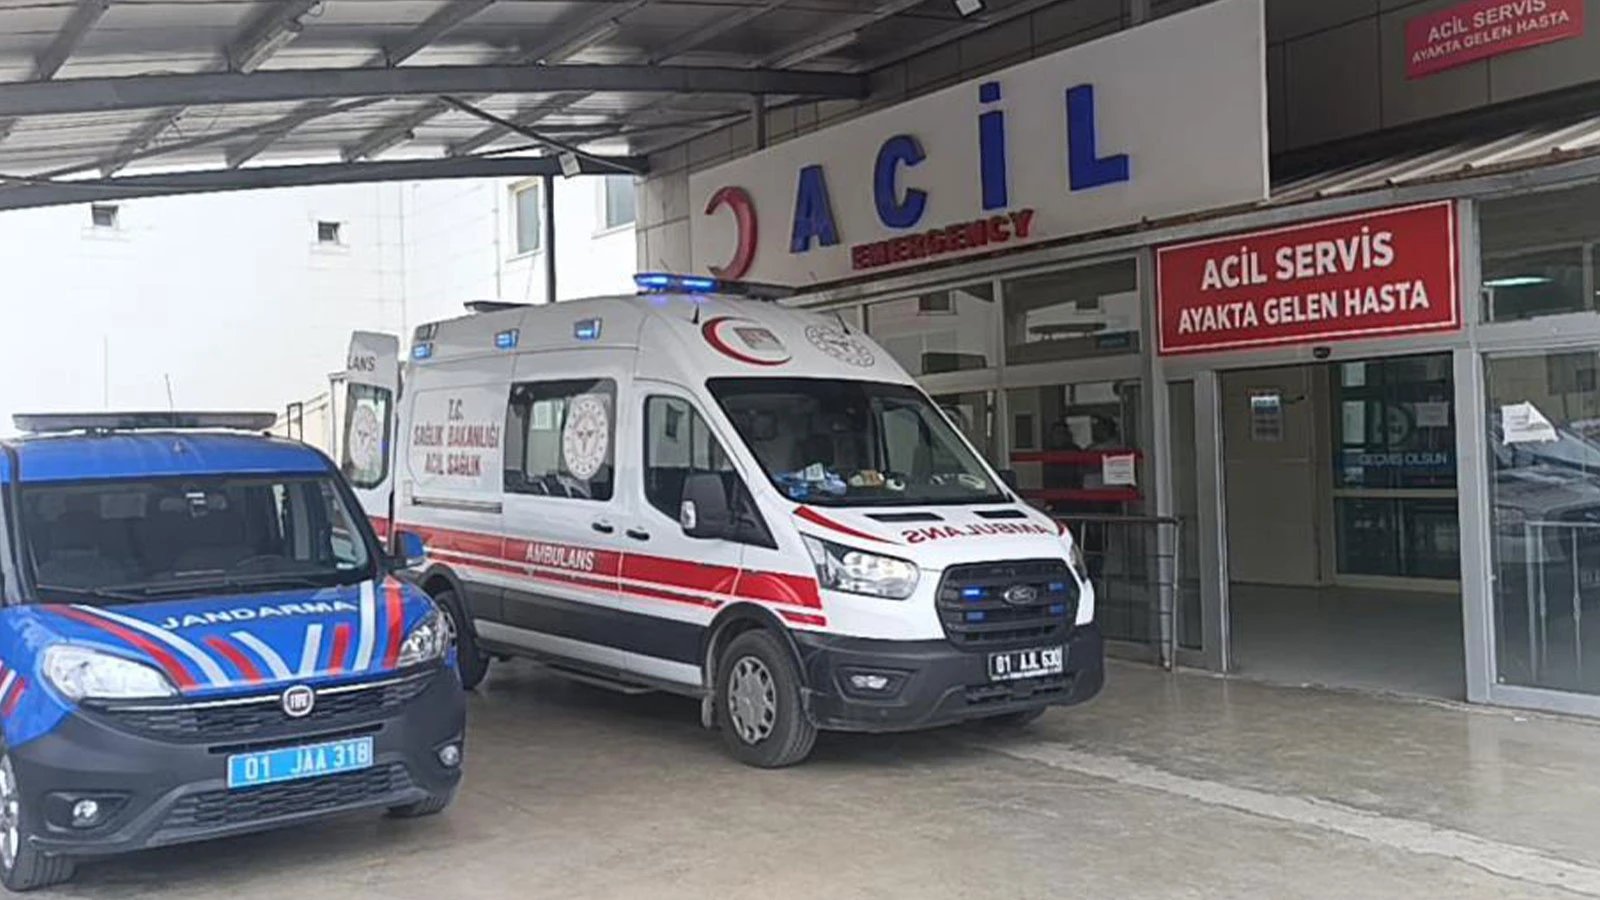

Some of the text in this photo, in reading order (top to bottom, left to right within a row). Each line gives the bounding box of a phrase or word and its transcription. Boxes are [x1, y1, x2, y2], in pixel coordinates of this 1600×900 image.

[1412, 9, 1570, 64] AYAKTA GELEN HASTA
[1428, 15, 1468, 43] ACİL
[790, 81, 1130, 254] ACİL
[851, 209, 1035, 271] EMERGENCY
[1201, 226, 1395, 291] ACİL SERVİS
[1178, 279, 1429, 334] AYAKTA GELEN HASTA
[525, 541, 595, 572] AMBULANS
[162, 600, 359, 630] JANDARMA
[996, 655, 1011, 674] 01
[245, 742, 369, 780] 01 JAA 318
